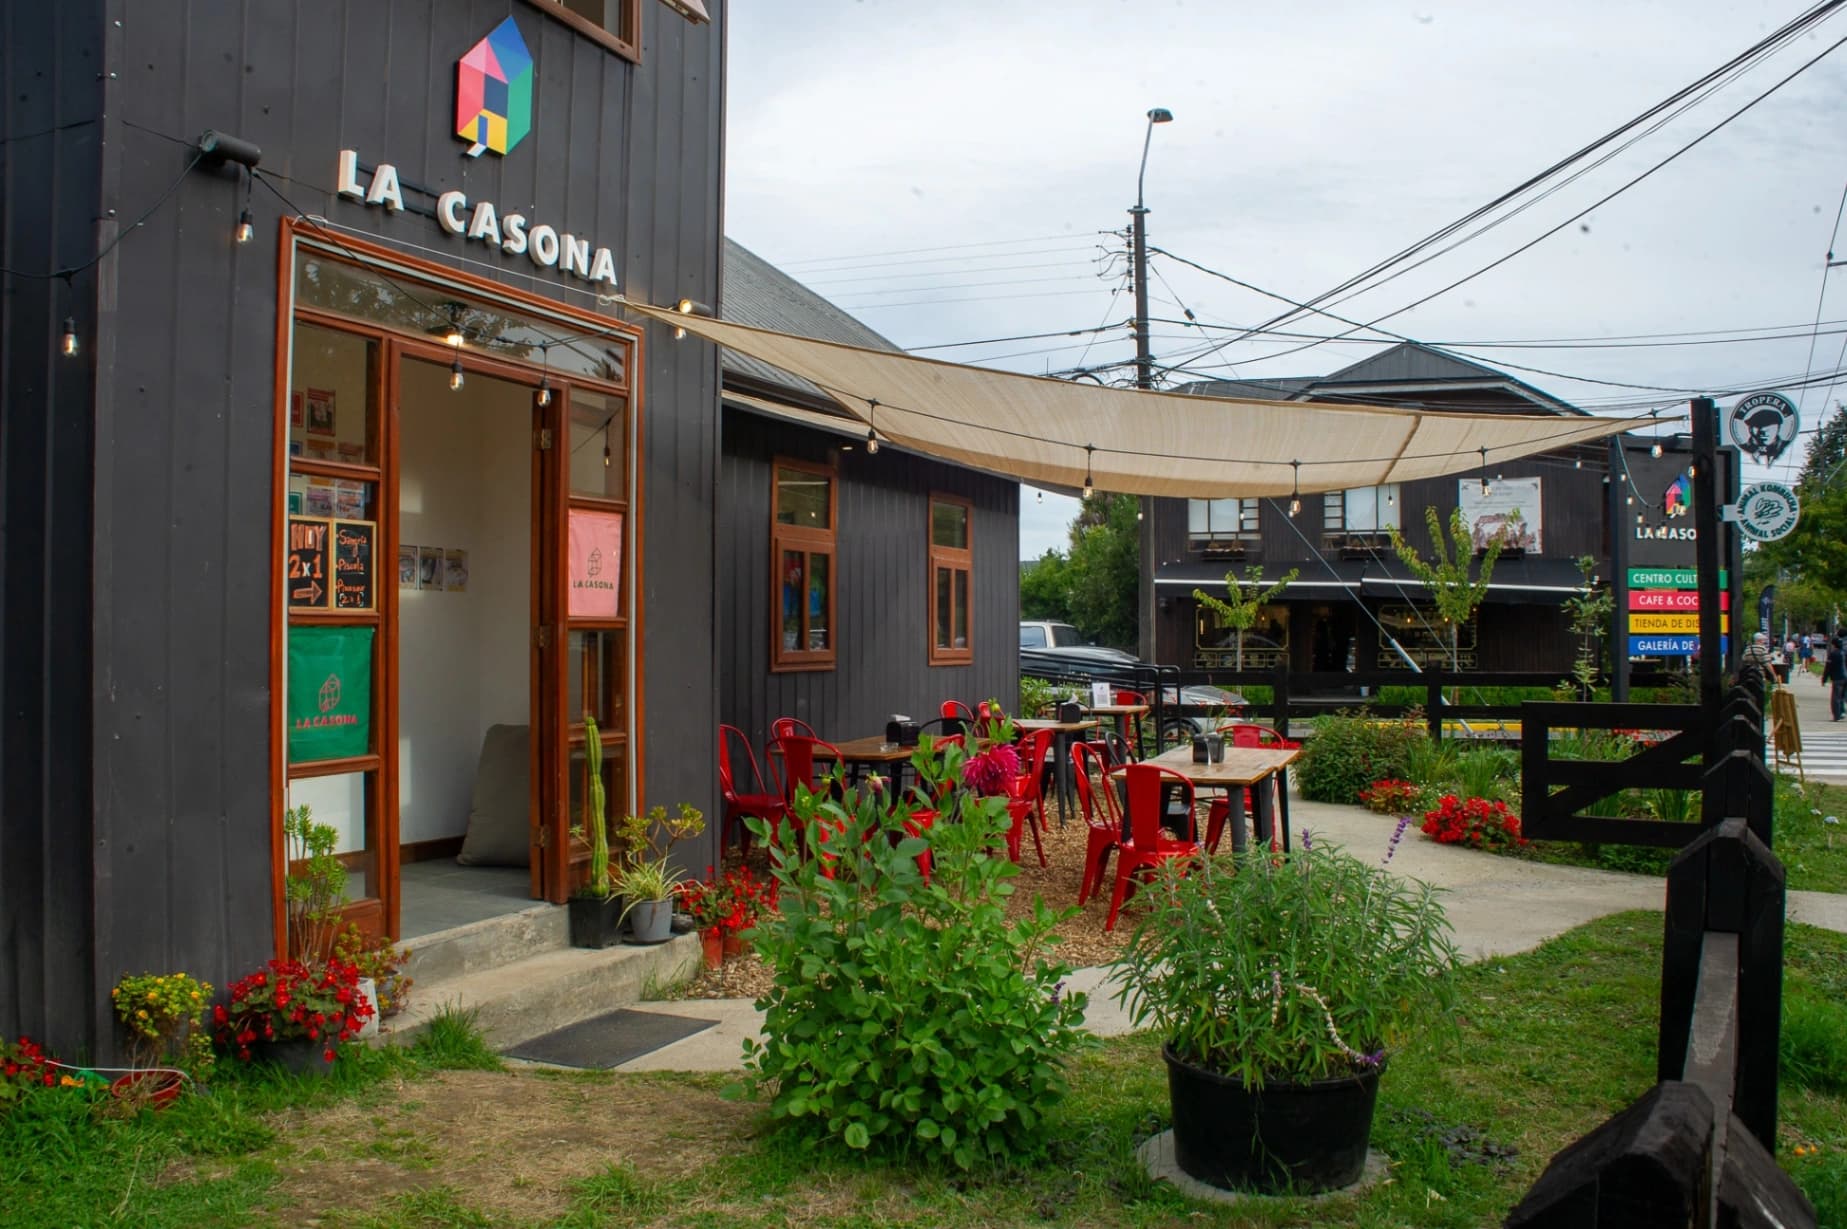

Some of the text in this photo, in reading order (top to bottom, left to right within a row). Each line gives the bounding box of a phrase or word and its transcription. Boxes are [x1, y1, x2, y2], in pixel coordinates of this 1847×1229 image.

[338, 149, 618, 286] LA CASONA
[1636, 526, 1697, 540] LA CASO
[289, 553, 323, 579] 2x1
[573, 580, 614, 590] LA CASONA
[1633, 573, 1698, 584] CENTRO CULT
[1639, 595, 1699, 606] CAFE & COC
[1634, 618, 1668, 628] TIENDA
[1671, 618, 1683, 628] DE
[1638, 638, 1679, 651] GALERÍA
[1681, 640, 1695, 651] DE
[313, 714, 358, 728] CASONA
